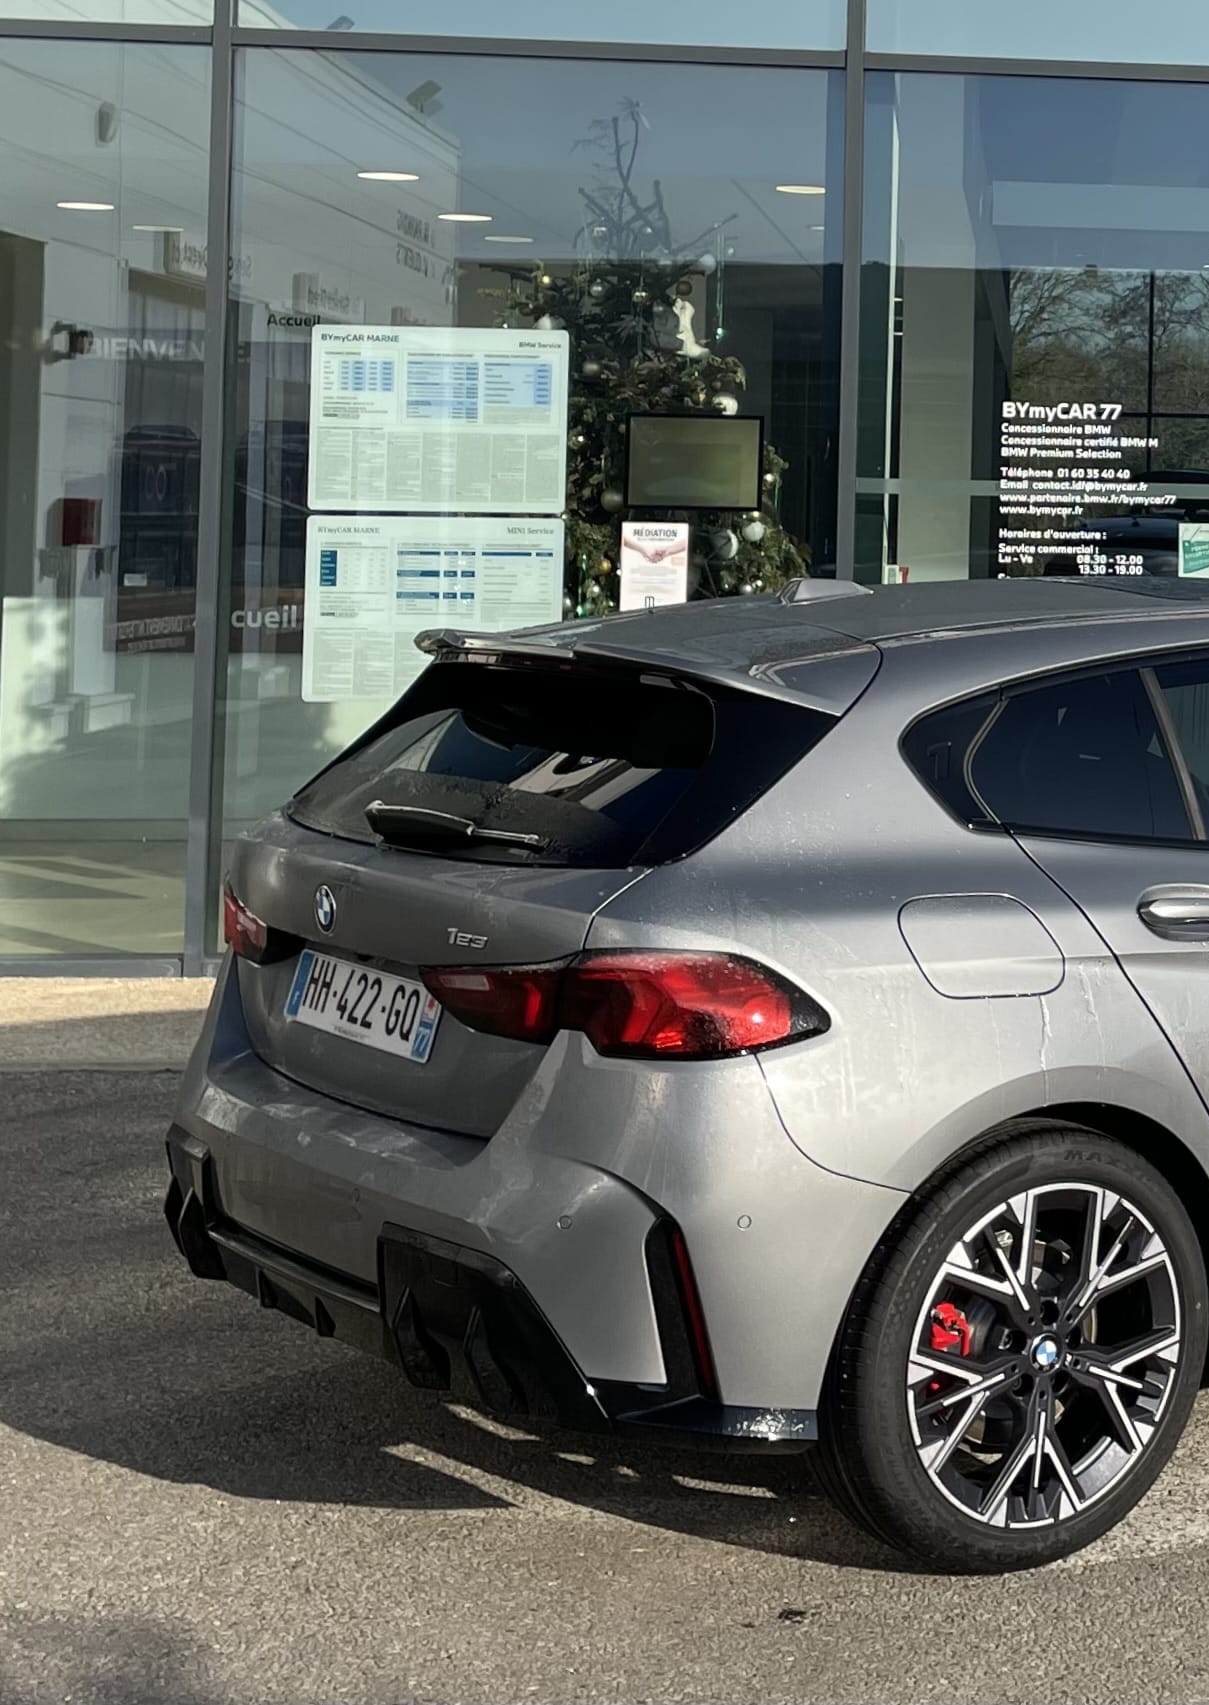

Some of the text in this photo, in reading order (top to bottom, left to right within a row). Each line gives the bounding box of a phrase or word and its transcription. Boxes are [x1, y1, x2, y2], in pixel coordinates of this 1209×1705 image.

[320, 333, 400, 343] BYmyCAR MARNE
[1001, 401, 1122, 422] BYmyCAR 77
[1001, 422, 1112, 435] Concessionnaire BMW
[1000, 434, 1159, 449] Concessionnaire certifié BMW M
[1000, 446, 1122, 460] BMW Premium Selection
[1000, 465, 1131, 480] Téléphone 01 60 35 40 40
[1000, 479, 1029, 490] Email
[999, 505, 1084, 518] www.bymycar.fr
[506, 526, 526, 535] MINI
[998, 528, 1042, 540] Horaires
[1043, 529, 1102, 540] d'ouverture
[997, 543, 1036, 554] Service
[1037, 544, 1095, 554] commercial
[998, 554, 1012, 564] Lu
[1018, 554, 1034, 564] Ve
[1076, 555, 1107, 565] 08.30
[1115, 555, 1143, 566] 12.00
[1078, 564, 1107, 575] 13.30
[1115, 565, 1143, 576] 19.00
[230, 604, 298, 629] cueil
